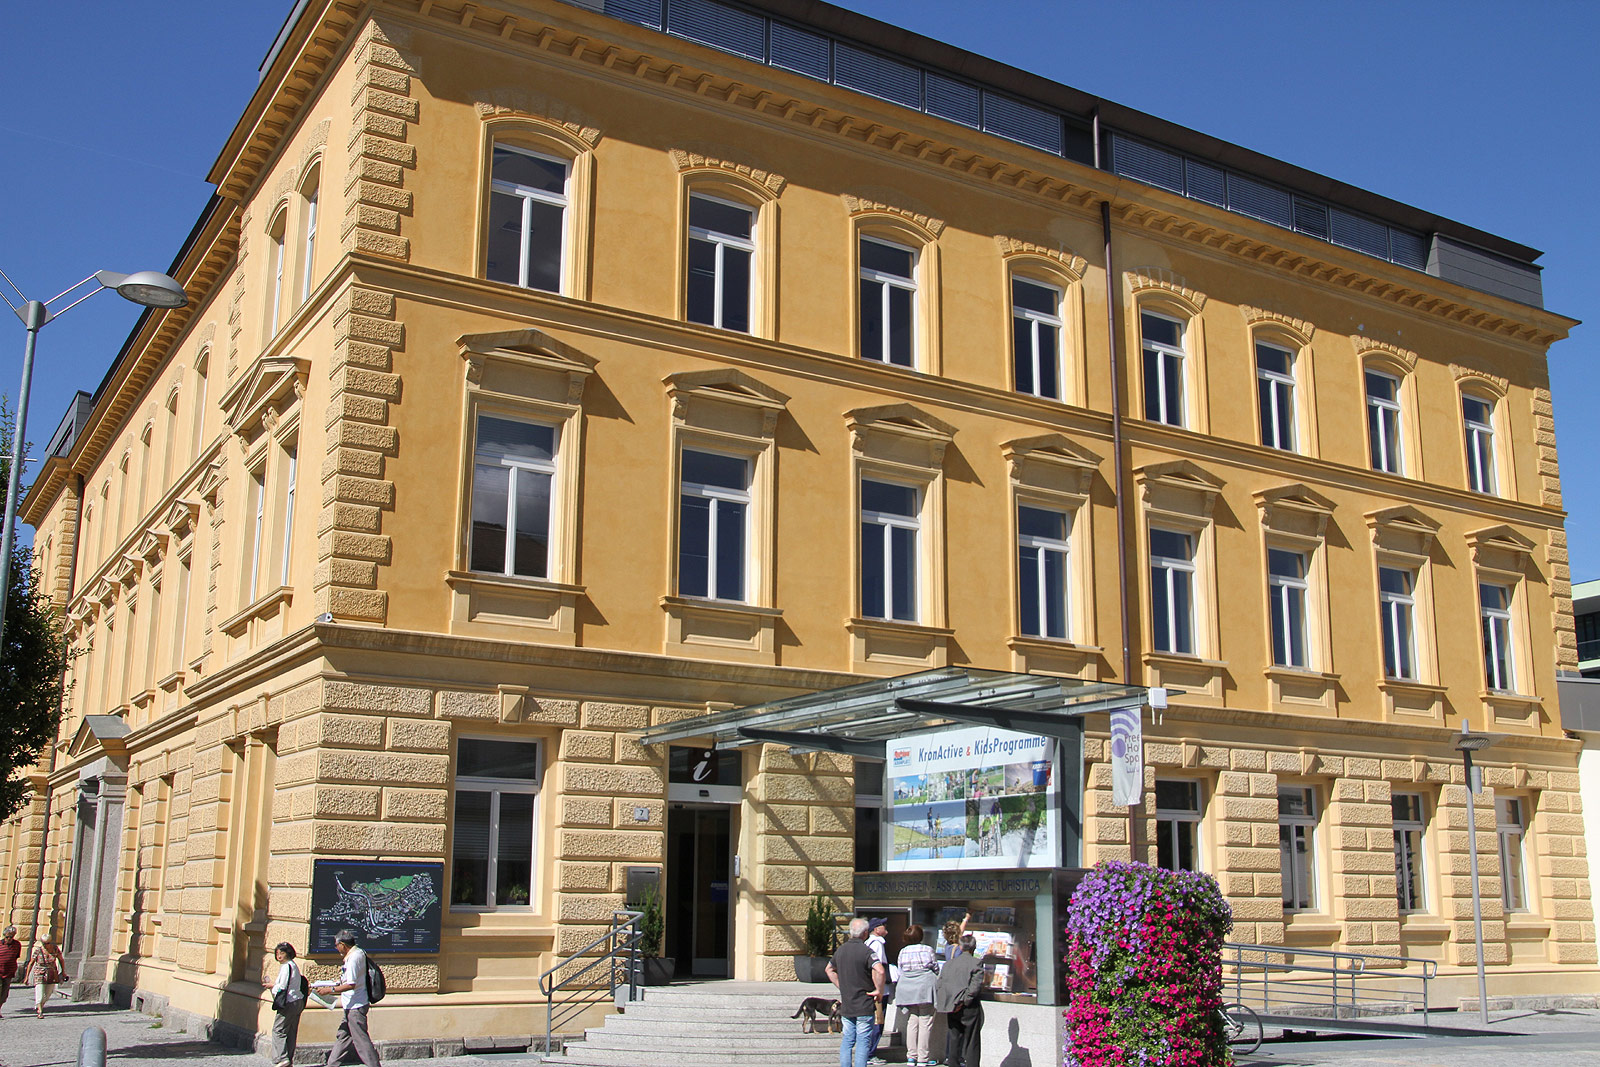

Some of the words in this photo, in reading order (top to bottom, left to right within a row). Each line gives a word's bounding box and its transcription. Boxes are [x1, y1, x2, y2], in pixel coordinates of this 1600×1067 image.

[918, 743, 964, 763] KronActive
[966, 746, 971, 757] &
[974, 736, 1046, 756] KidsProgramme
[864, 881, 929, 893] TOURISMUSVEREIN
[936, 880, 995, 892] ASSOCIAZIONE
[997, 879, 1040, 892] TURISTICA
